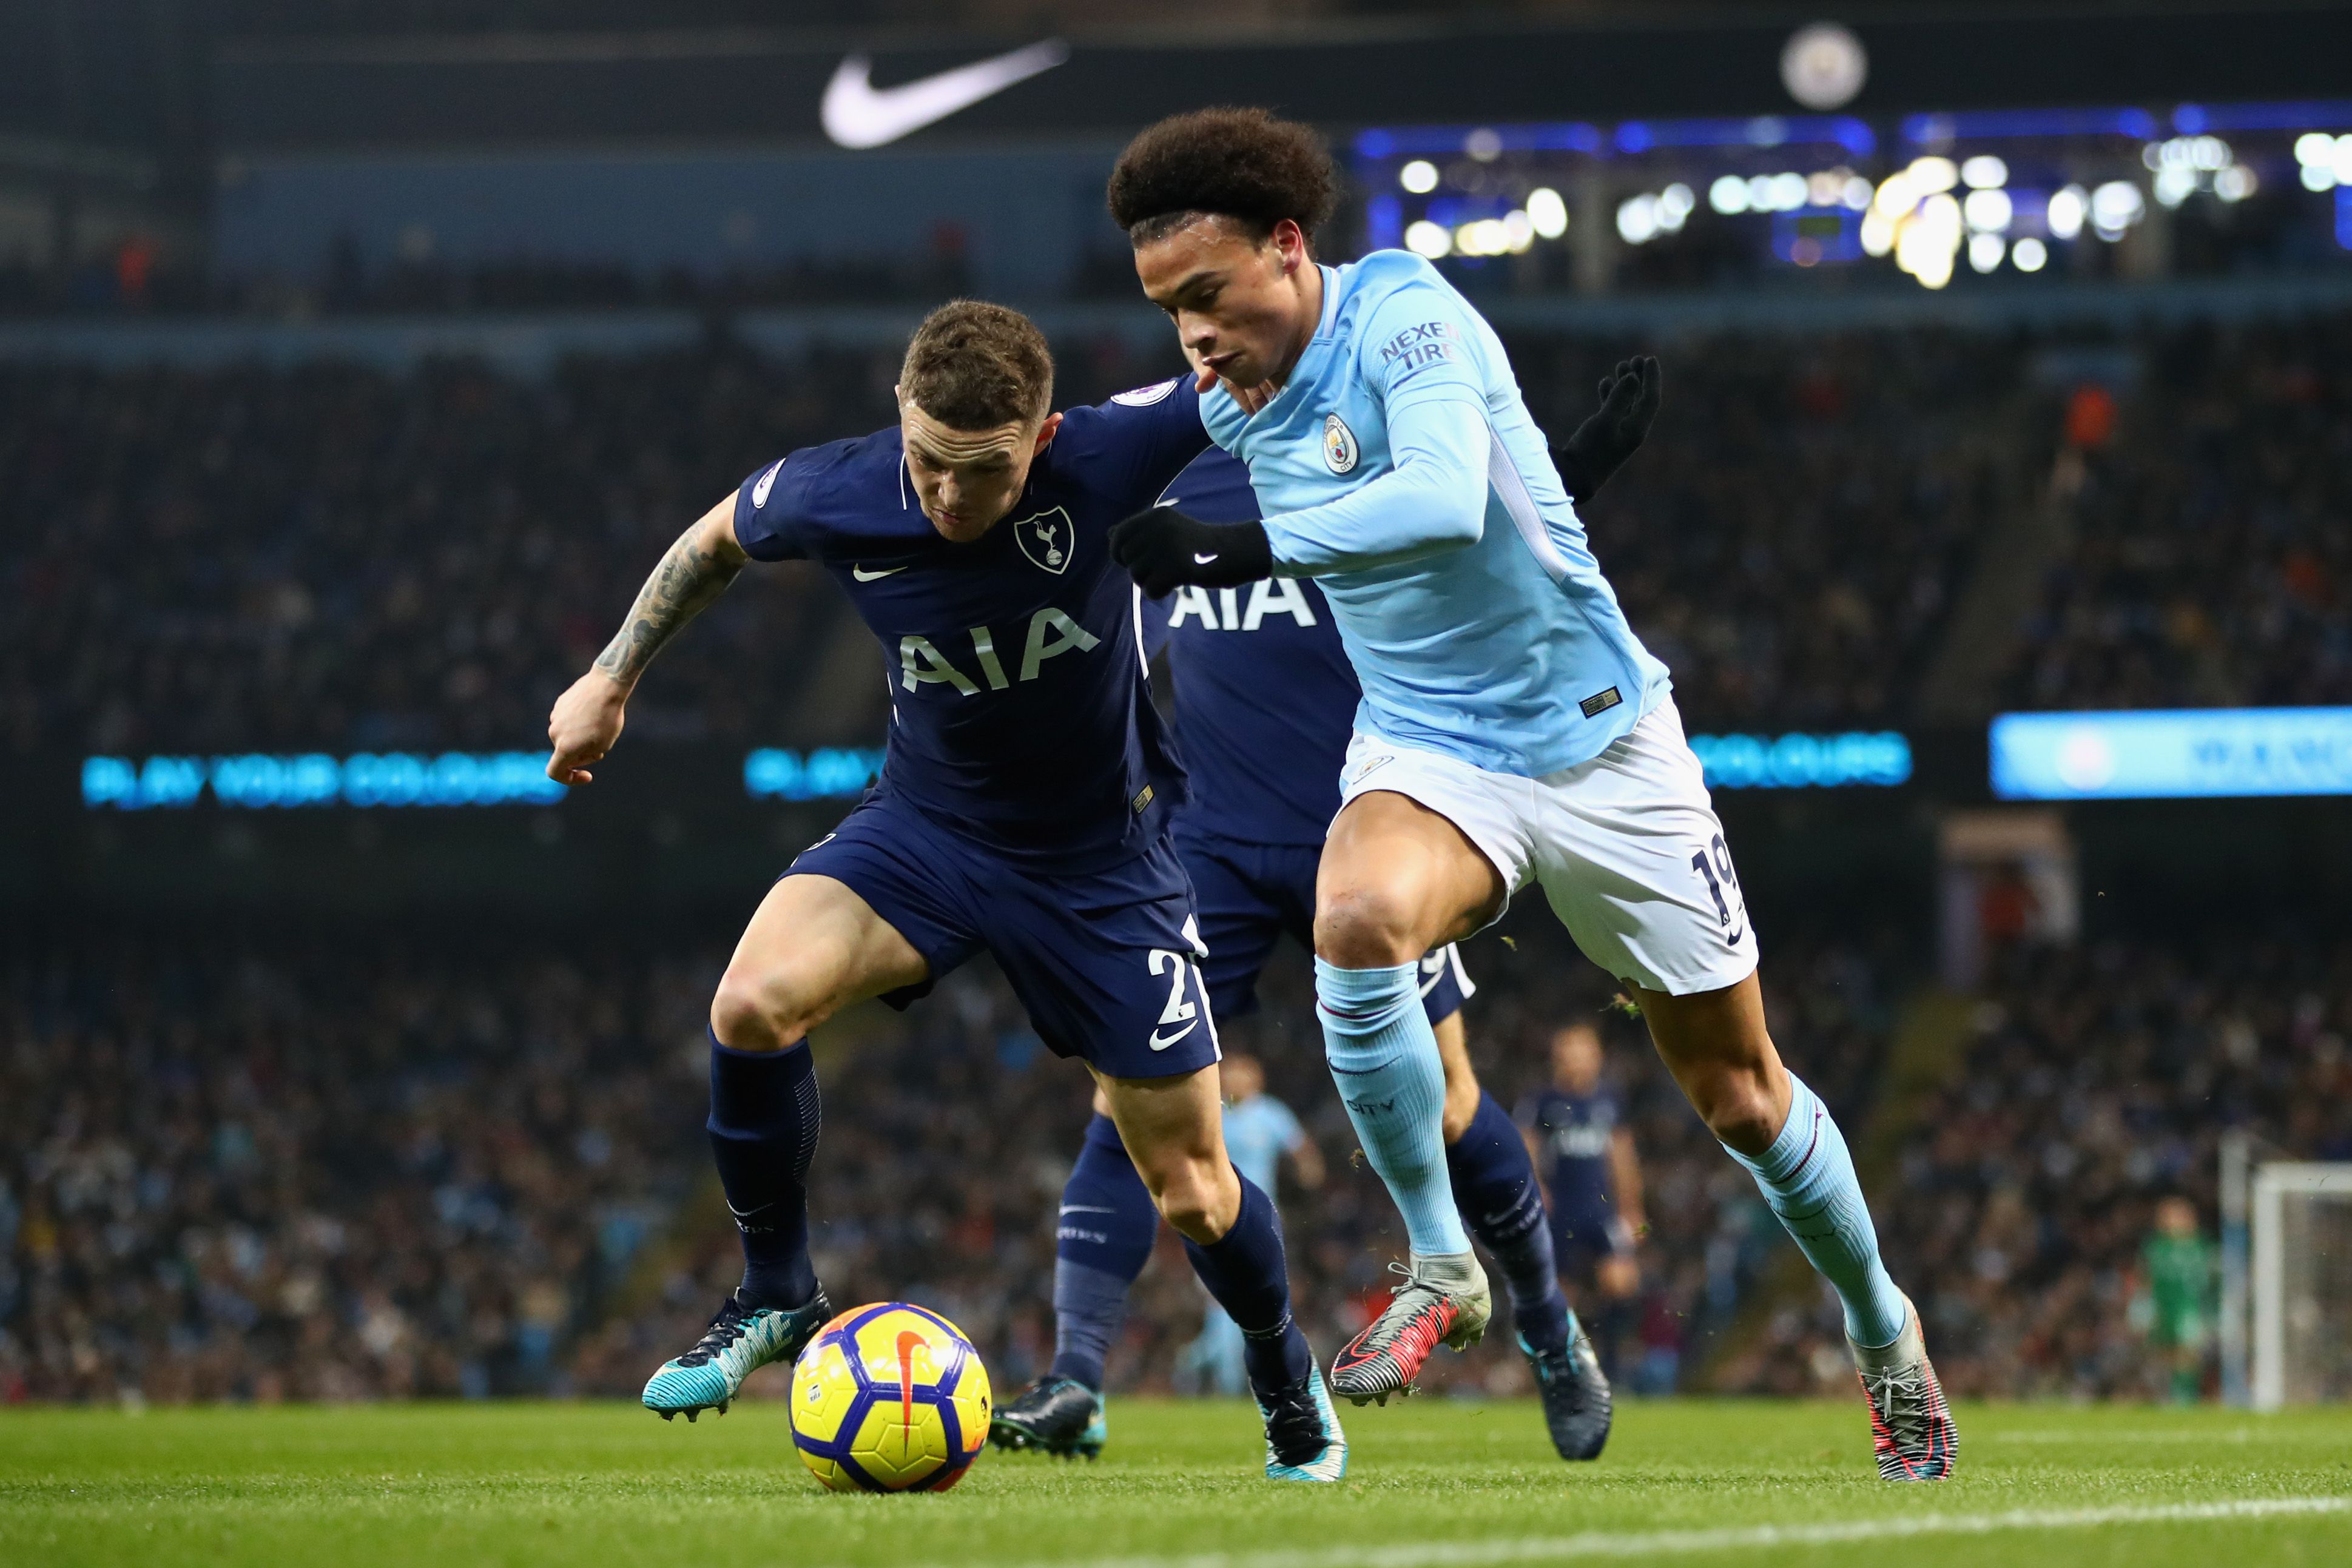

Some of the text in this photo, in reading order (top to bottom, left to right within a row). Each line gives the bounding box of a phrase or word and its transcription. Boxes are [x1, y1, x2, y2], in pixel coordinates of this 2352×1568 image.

[1167, 577, 1318, 631] AIA
[899, 607, 1102, 696] AIA
[1691, 832, 1738, 927] 19
[1148, 948, 1196, 1025] 2
[1346, 1099, 1395, 1116] CITY
